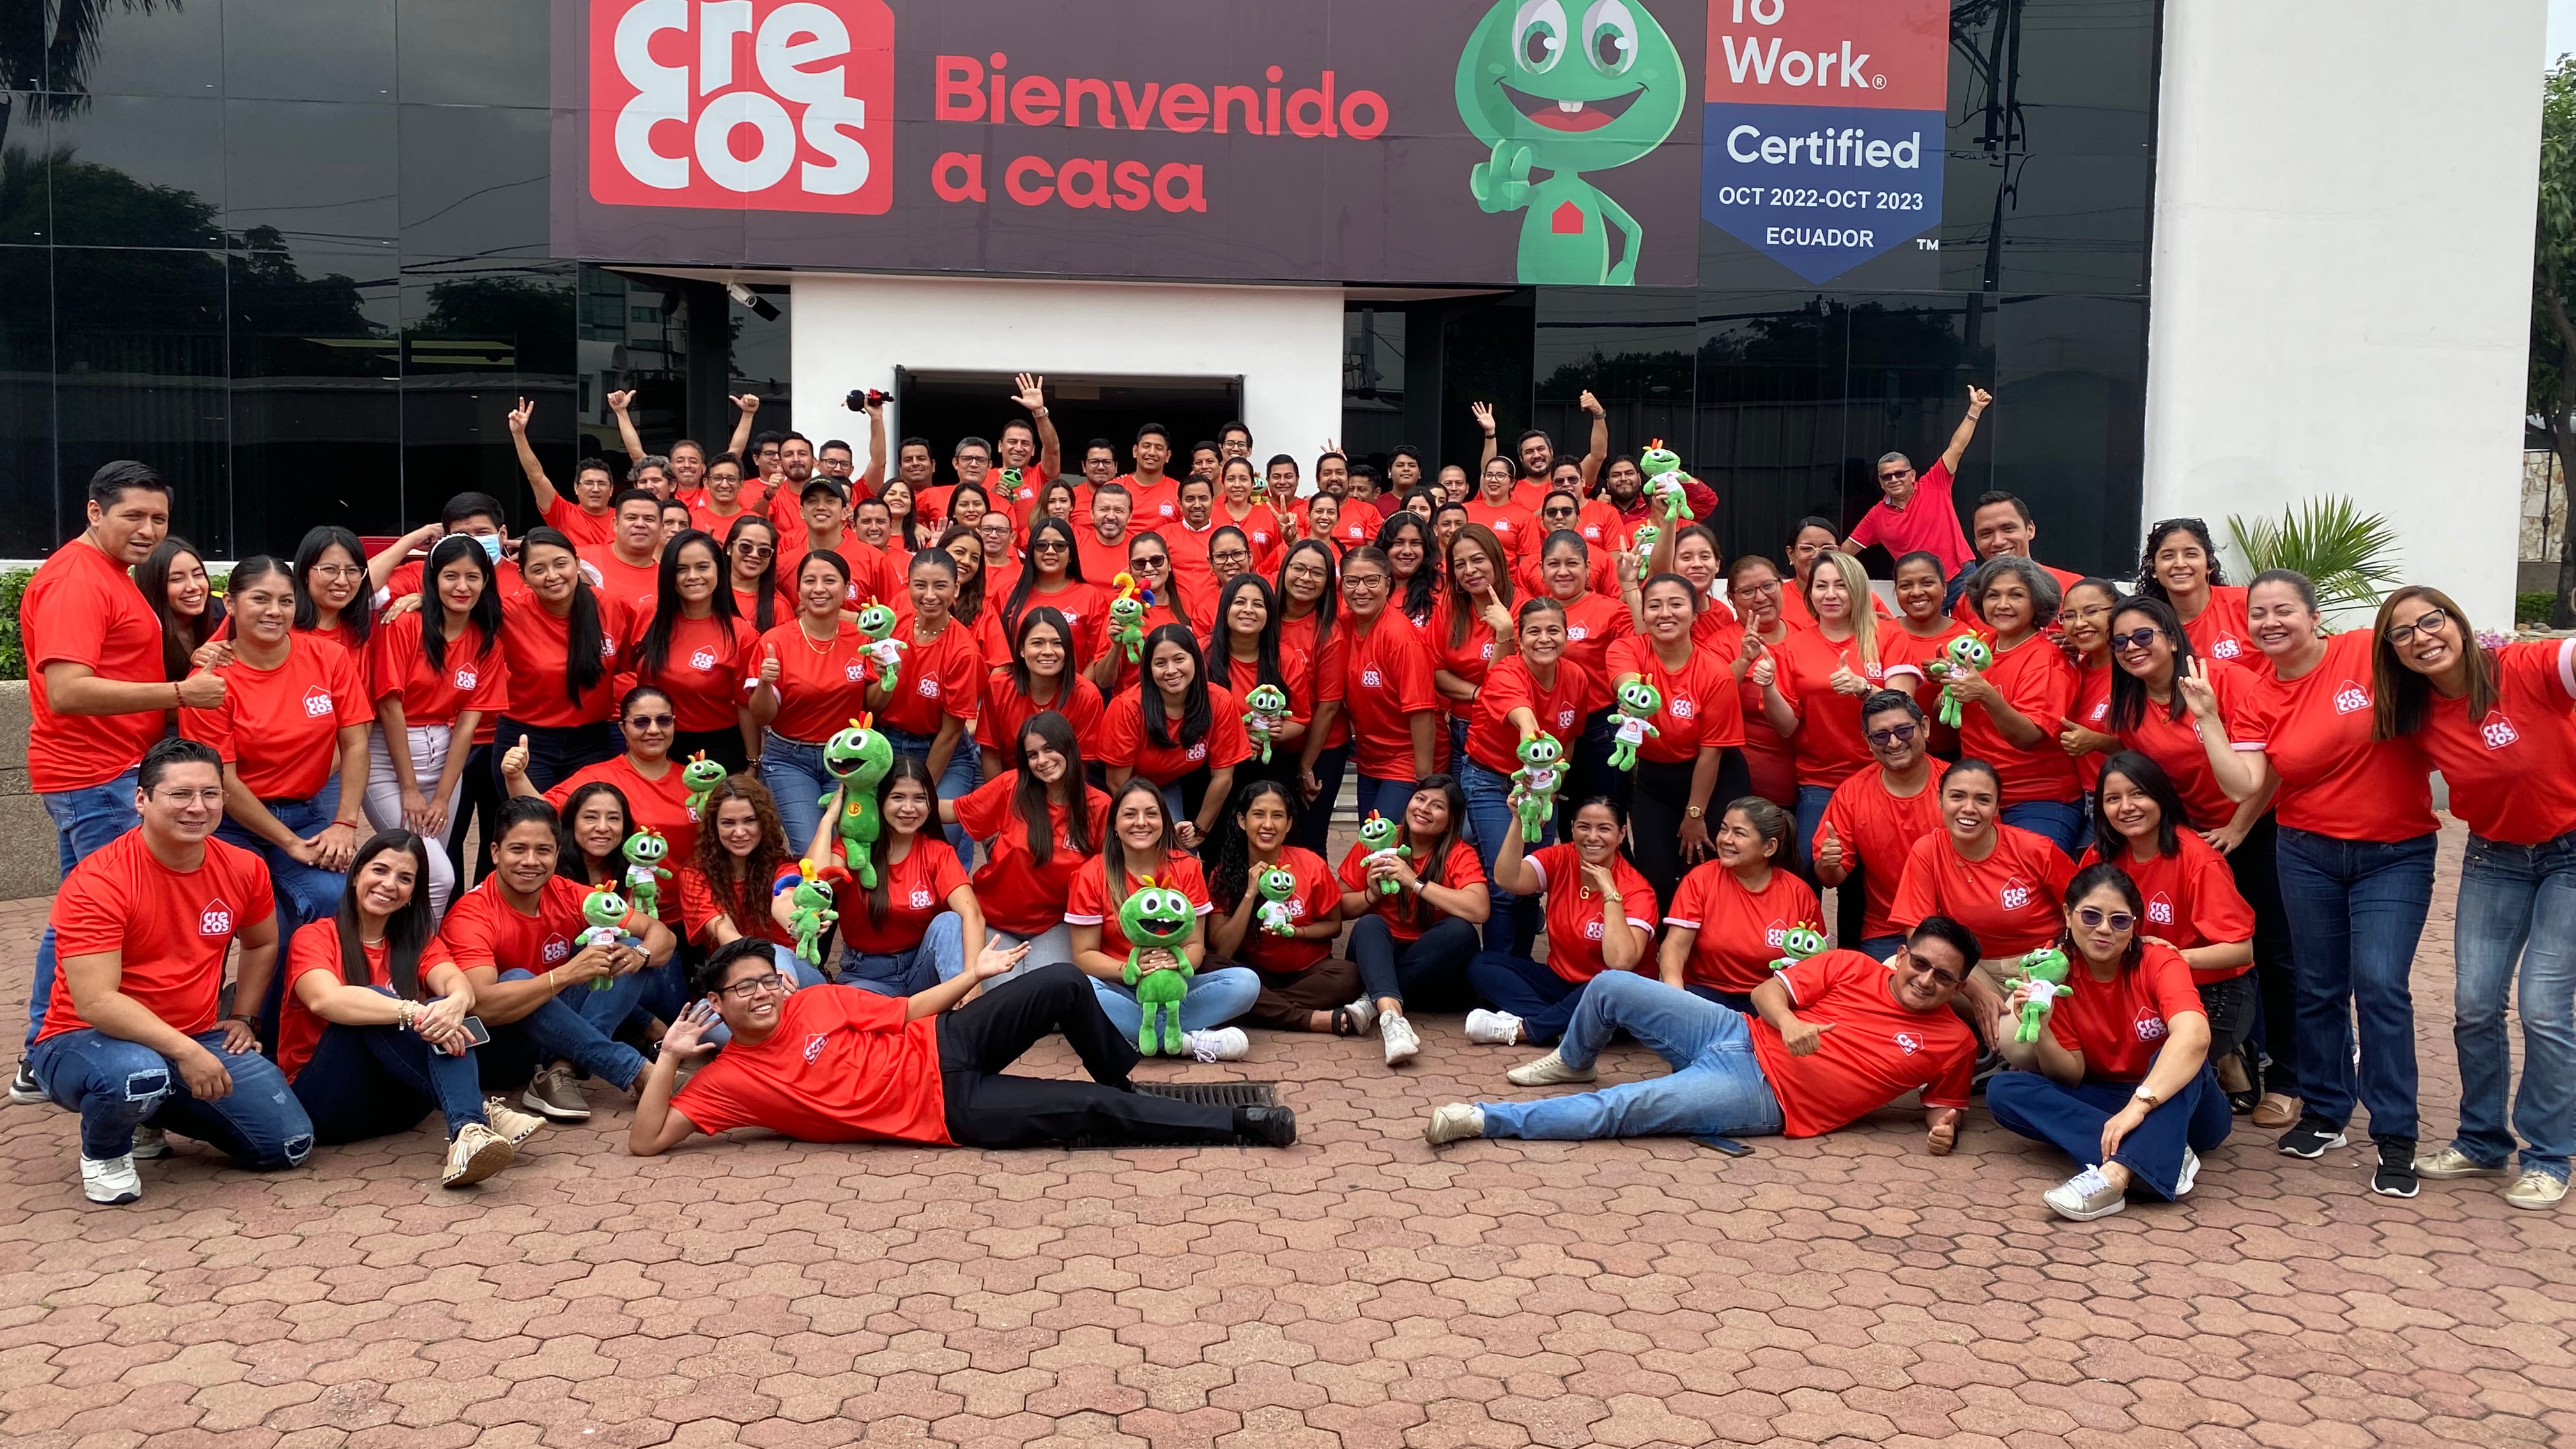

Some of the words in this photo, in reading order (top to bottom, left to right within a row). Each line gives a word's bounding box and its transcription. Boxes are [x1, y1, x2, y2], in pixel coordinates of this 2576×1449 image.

[935, 52, 1390, 141] Bienvenido
[615, 91, 870, 195] cos
[1727, 125, 1920, 169] Certified
[931, 151, 986, 203] a
[1004, 155, 1208, 213] casa
[1719, 186, 1765, 205] OCT
[1770, 188, 1871, 209] 2022-OCT
[1876, 192, 1924, 211] 2023
[1766, 227, 1874, 248] ECUADOR
[2214, 640, 2236, 651] cre
[694, 652, 714, 661] cre
[2215, 646, 2239, 659] cos
[458, 670, 475, 678] cre
[921, 678, 938, 689] cre
[1363, 677, 1379, 686] cos
[919, 686, 937, 696] cos
[2337, 689, 2361, 703] cre
[306, 694, 328, 705] cre
[1674, 700, 1691, 709] cre
[2338, 695, 2368, 710] cos
[1560, 710, 1574, 718] cre
[2488, 728, 2515, 747] cos
[912, 890, 928, 900] cre
[2004, 887, 2027, 899] cre
[912, 898, 931, 907] cos
[2150, 901, 2170, 911] cre
[1290, 906, 1303, 916] os
[2150, 910, 2170, 922] cos
[203, 912, 228, 922] cre
[203, 921, 229, 933] cos
[1586, 928, 1604, 938] co
[544, 940, 565, 951] cre
[1768, 935, 1782, 946] co
[545, 947, 567, 961] cos
[2136, 1017, 2160, 1030] cre
